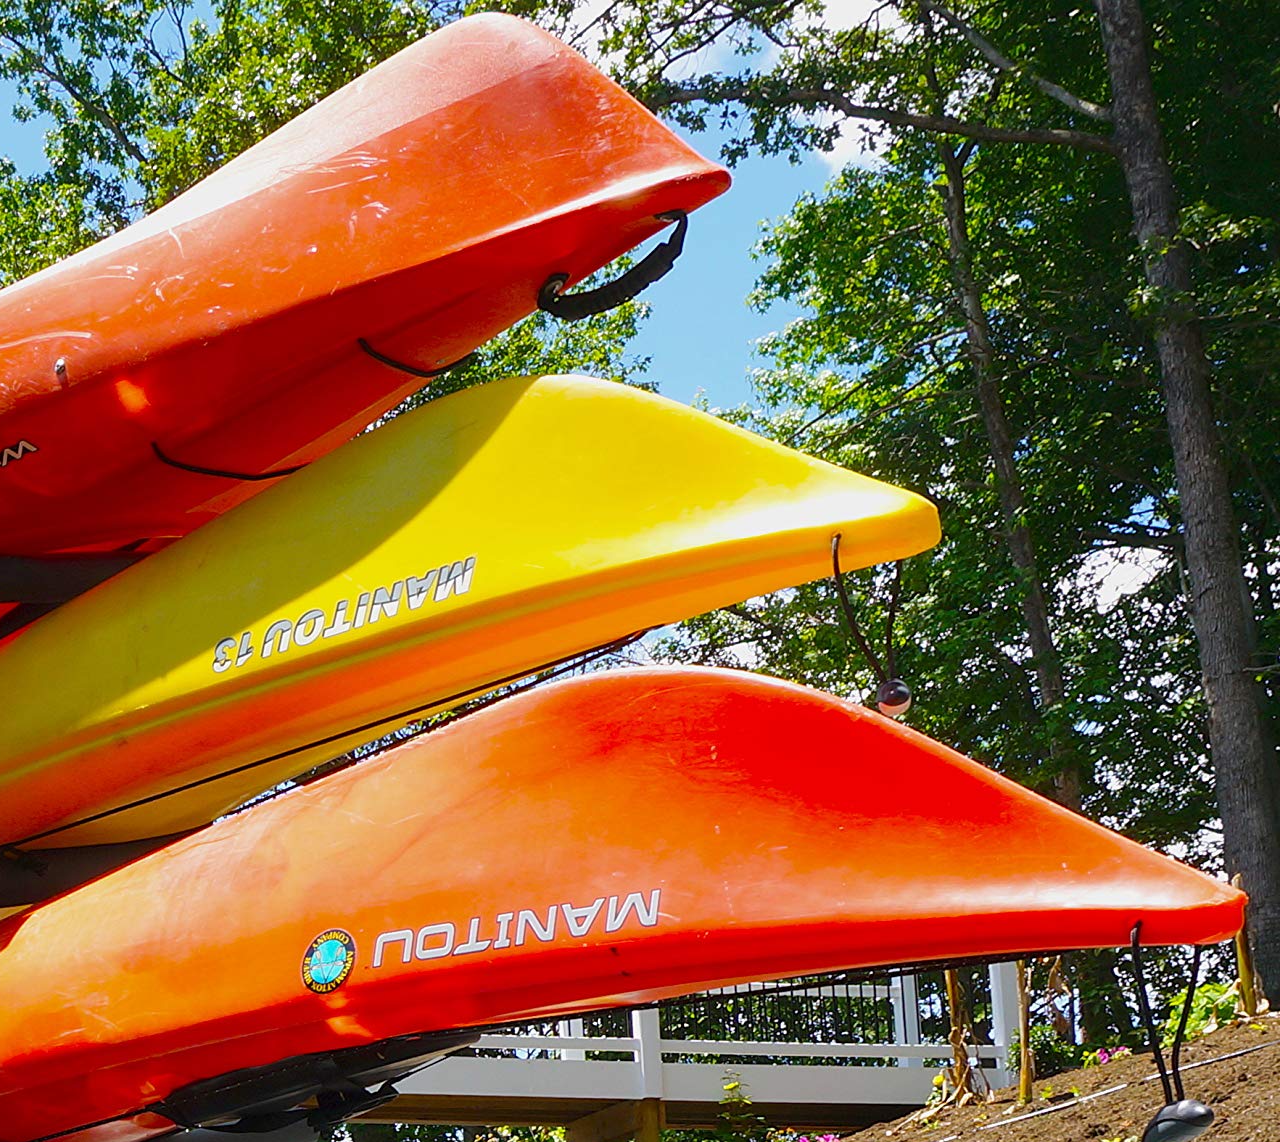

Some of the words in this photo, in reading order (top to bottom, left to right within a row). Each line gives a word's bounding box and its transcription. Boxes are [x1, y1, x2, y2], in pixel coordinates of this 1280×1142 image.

[261, 556, 476, 658] MANITOU
[212, 631, 254, 673] 13
[312, 931, 350, 950] COMPANY
[372, 889, 661, 968] MANITOU
